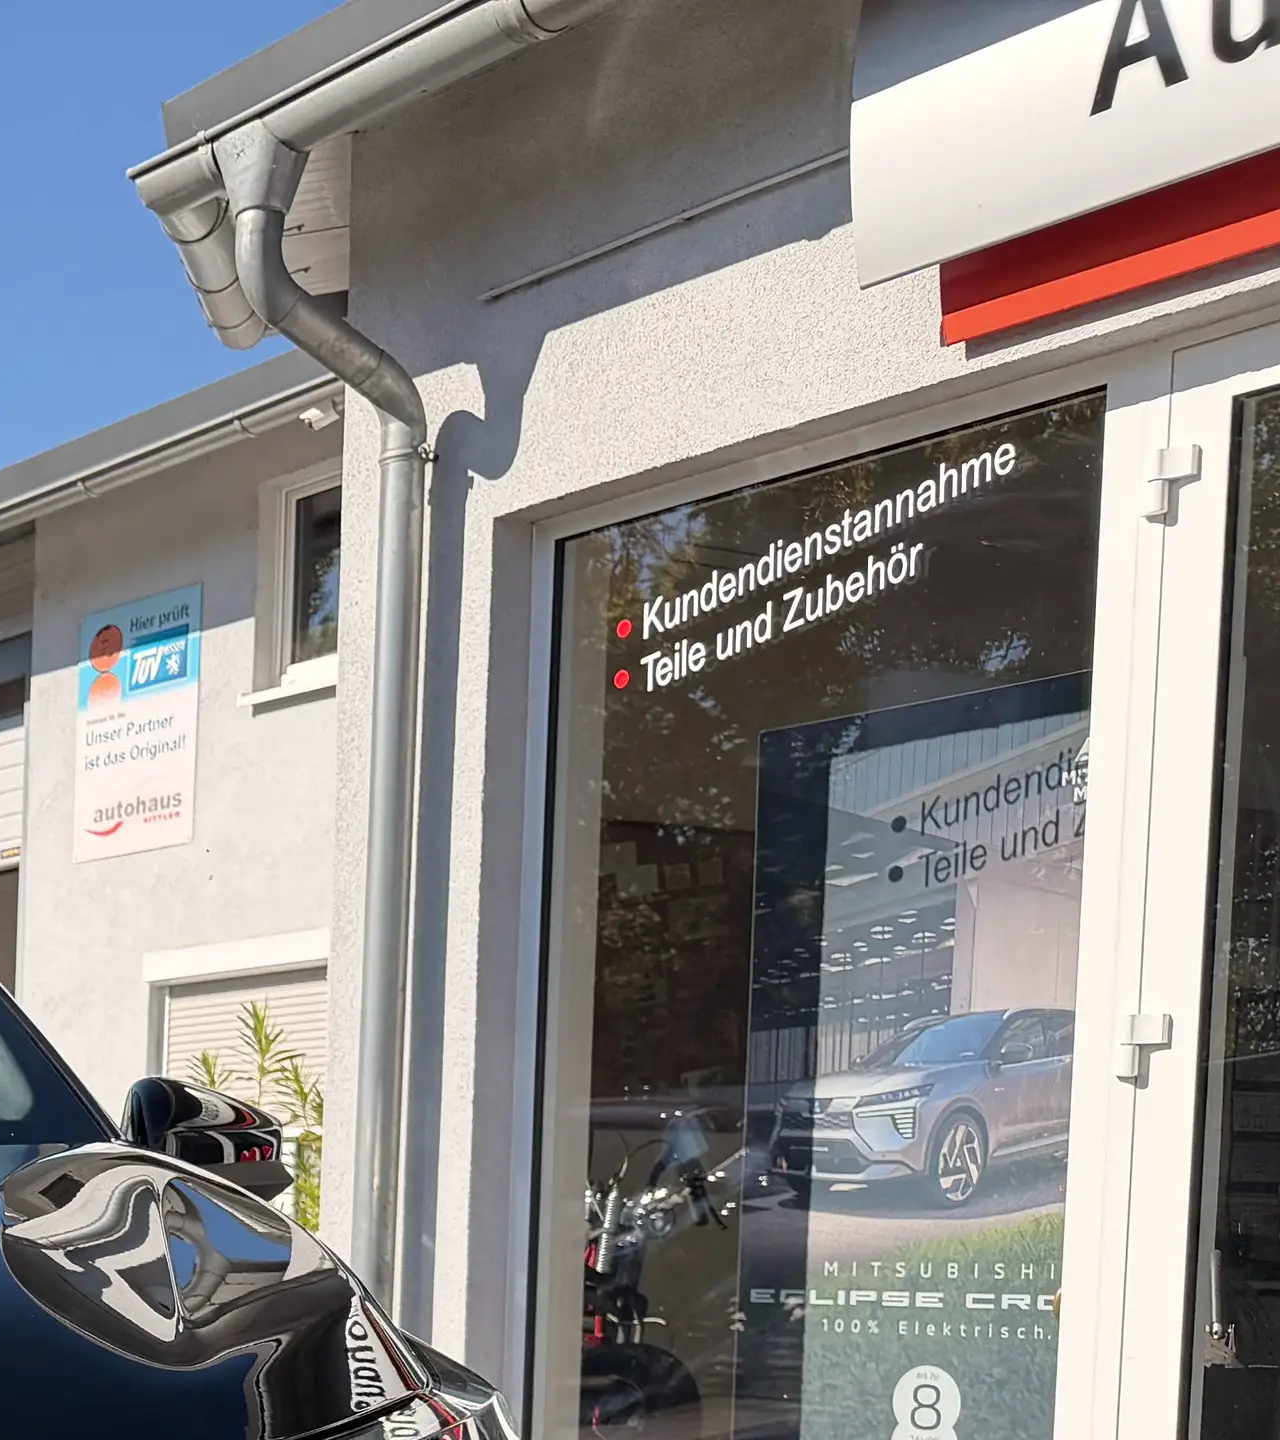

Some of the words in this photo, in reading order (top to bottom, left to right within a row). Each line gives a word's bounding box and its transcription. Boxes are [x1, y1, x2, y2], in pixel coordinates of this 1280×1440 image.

[642, 441, 1016, 640] Kundendienstannahme
[129, 615, 156, 633] Hier
[641, 640, 706, 692] Teile
[716, 602, 772, 661] und
[783, 542, 924, 632] Zubehör
[86, 727, 122, 746] Unser
[127, 714, 175, 737] Partner
[84, 755, 100, 771] ist
[103, 751, 126, 767] das
[130, 733, 186, 760] Original!
[93, 792, 182, 824] autohaus
[824, 1260, 1054, 1280] MITSUBISHI
[750, 1289, 944, 1309] ECLIPSE
[822, 1318, 880, 1335] 100%
[898, 1320, 1051, 1340] Elektrisch.
[910, 1384, 942, 1430] 8
